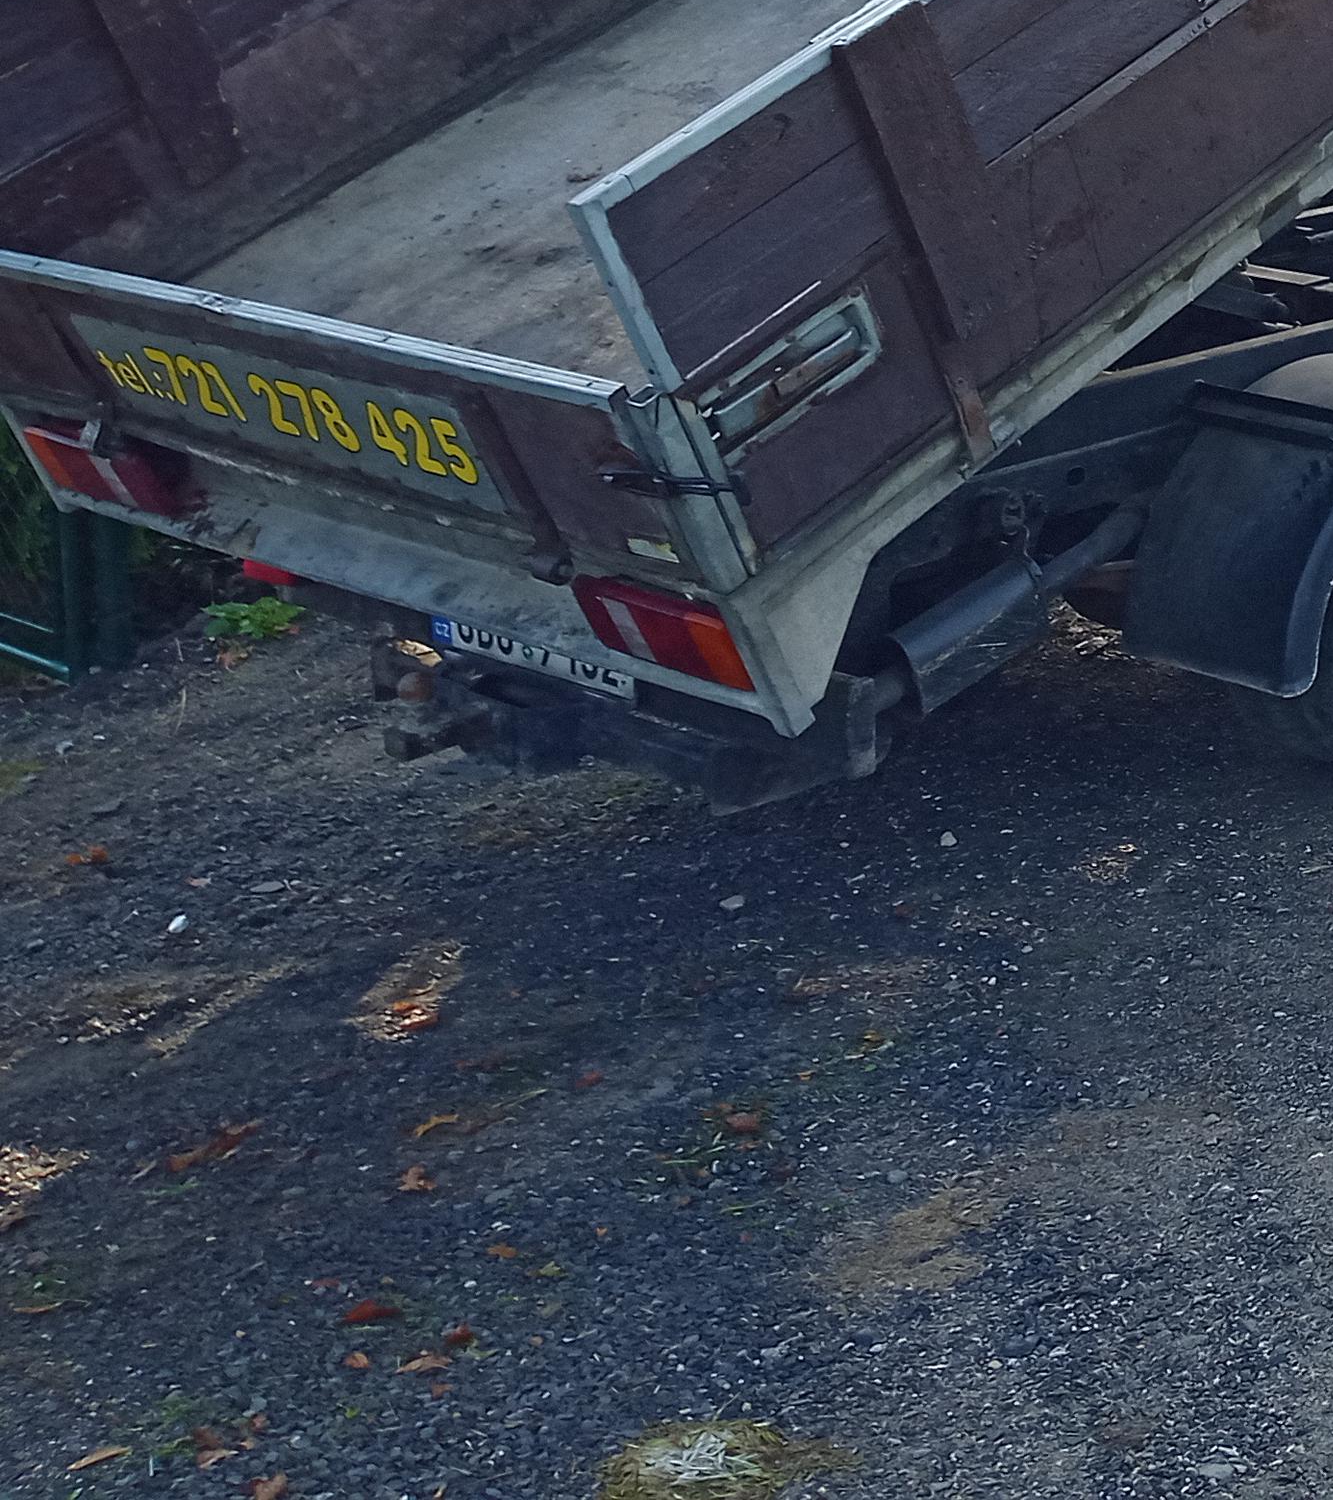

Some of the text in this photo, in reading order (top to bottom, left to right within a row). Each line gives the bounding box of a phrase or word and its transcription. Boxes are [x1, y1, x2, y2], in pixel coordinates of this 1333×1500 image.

[97, 346, 479, 485] tel.: 721 278 425
[434, 621, 450, 638] CZ
